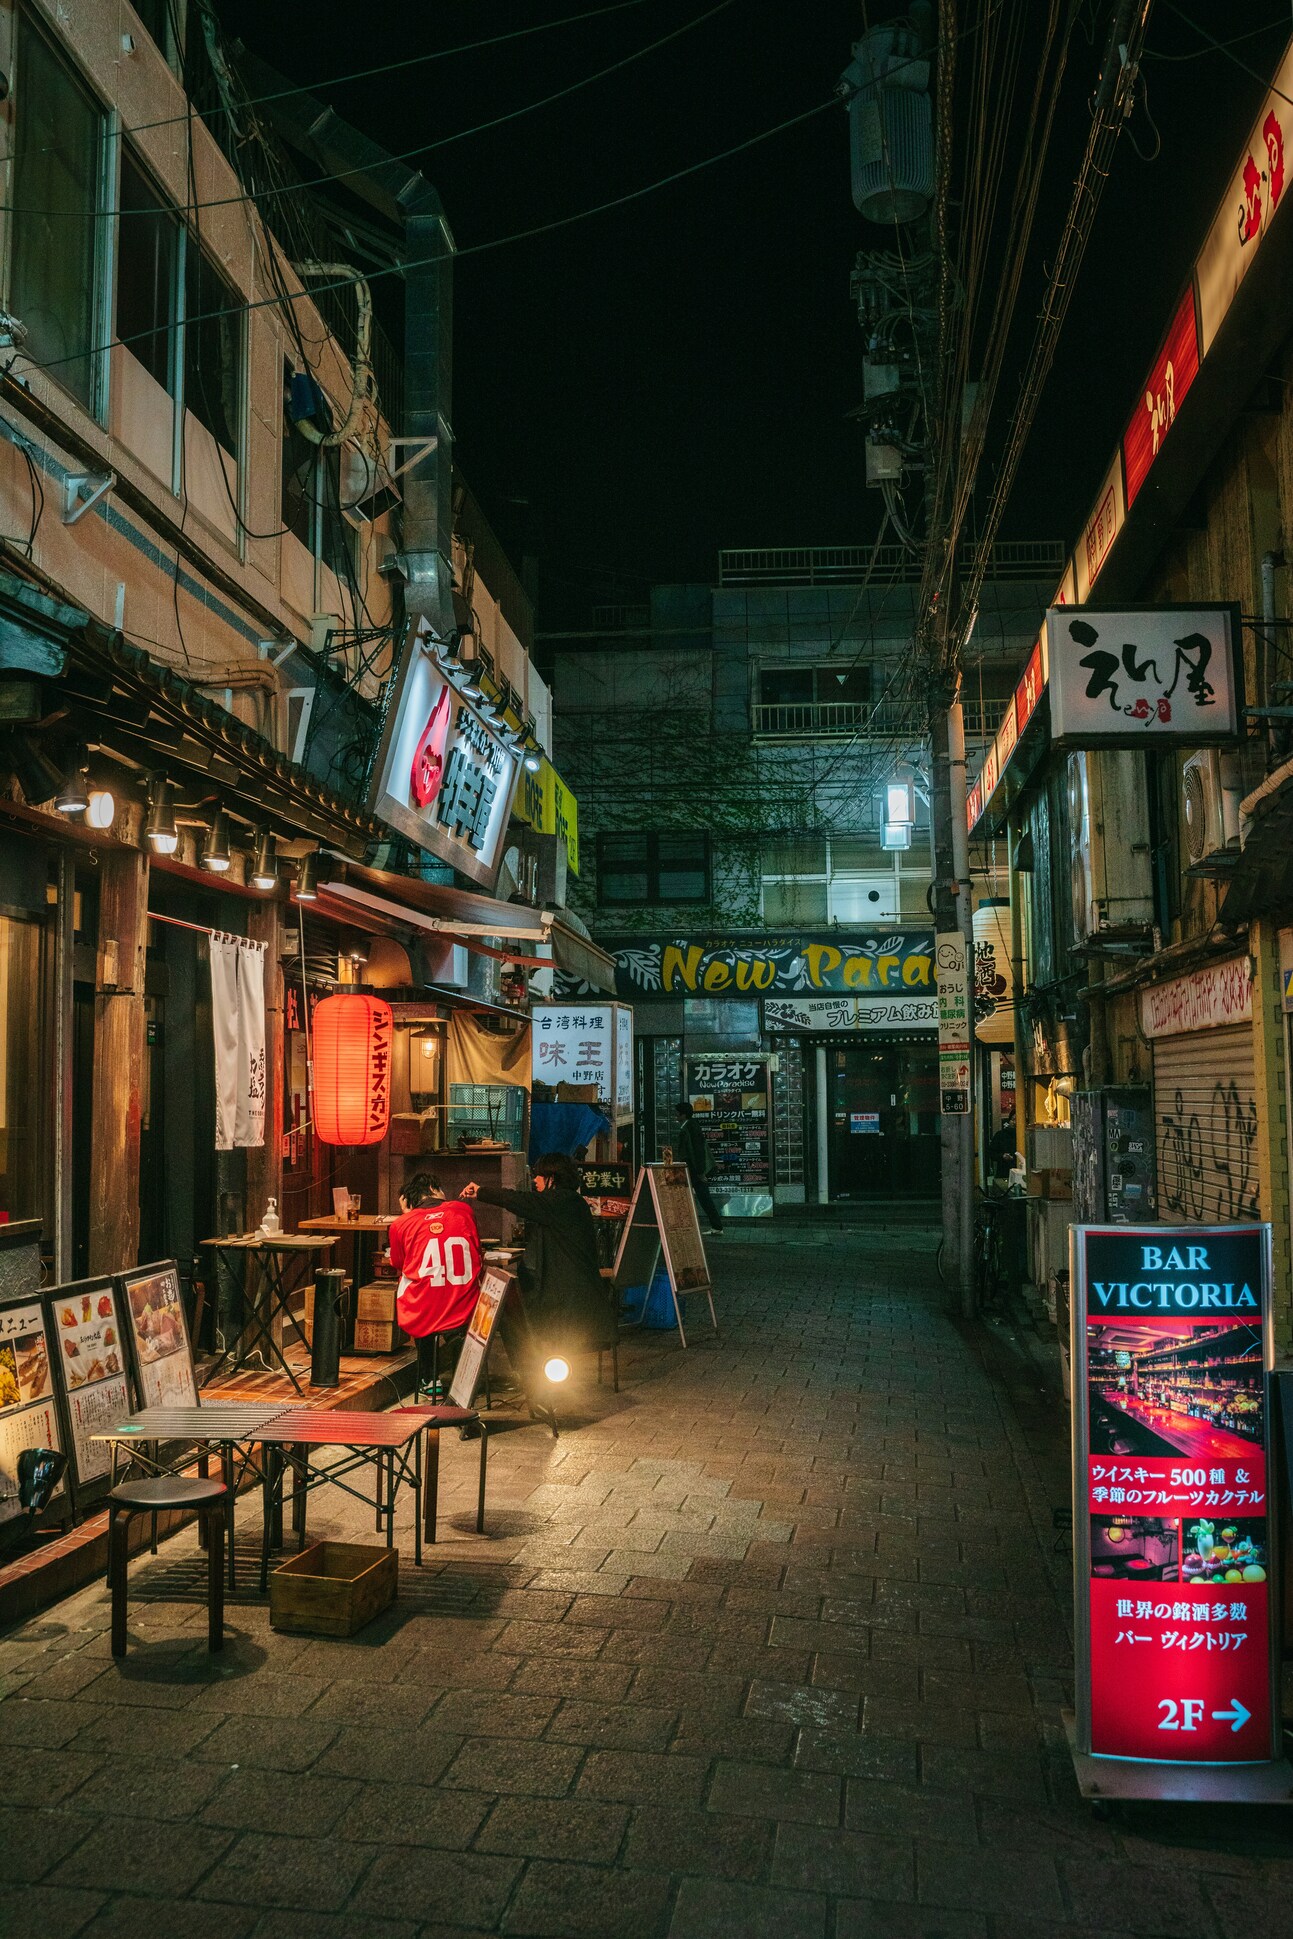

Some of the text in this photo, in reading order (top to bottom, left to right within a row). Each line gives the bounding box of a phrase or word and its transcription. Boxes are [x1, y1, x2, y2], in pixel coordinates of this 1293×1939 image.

[1069, 619, 1217, 711] えん屋
[705, 939, 736, 948] カラオケ
[662, 943, 938, 992] New Para
[939, 983, 963, 994] おうじ
[808, 999, 848, 1011] 当店自慢の
[540, 1015, 604, 1030] 台湾料理
[540, 1040, 604, 1067] 味王
[370, 1010, 390, 1132] ジンギスカン
[572, 1070, 605, 1082] 中野店
[695, 1062, 760, 1081] カラオケ
[1001, 1070, 1016, 1080] 中野
[1001, 1081, 1016, 1089] 中野
[583, 1171, 625, 1190] 営業中
[419, 1236, 473, 1287] 40
[1141, 1246, 1211, 1270] BAR
[1092, 1283, 1257, 1307] VICTORIA
[1092, 1465, 1165, 1483] ウイスキー
[1170, 1469, 1206, 1486] 500
[1092, 1488, 1265, 1505] 季節のフルーツカクテル
[1116, 1599, 1248, 1622] 世界の銘酒多数
[1161, 1631, 1248, 1651] ヴィクトリア
[1158, 1699, 1205, 1731] 2F
